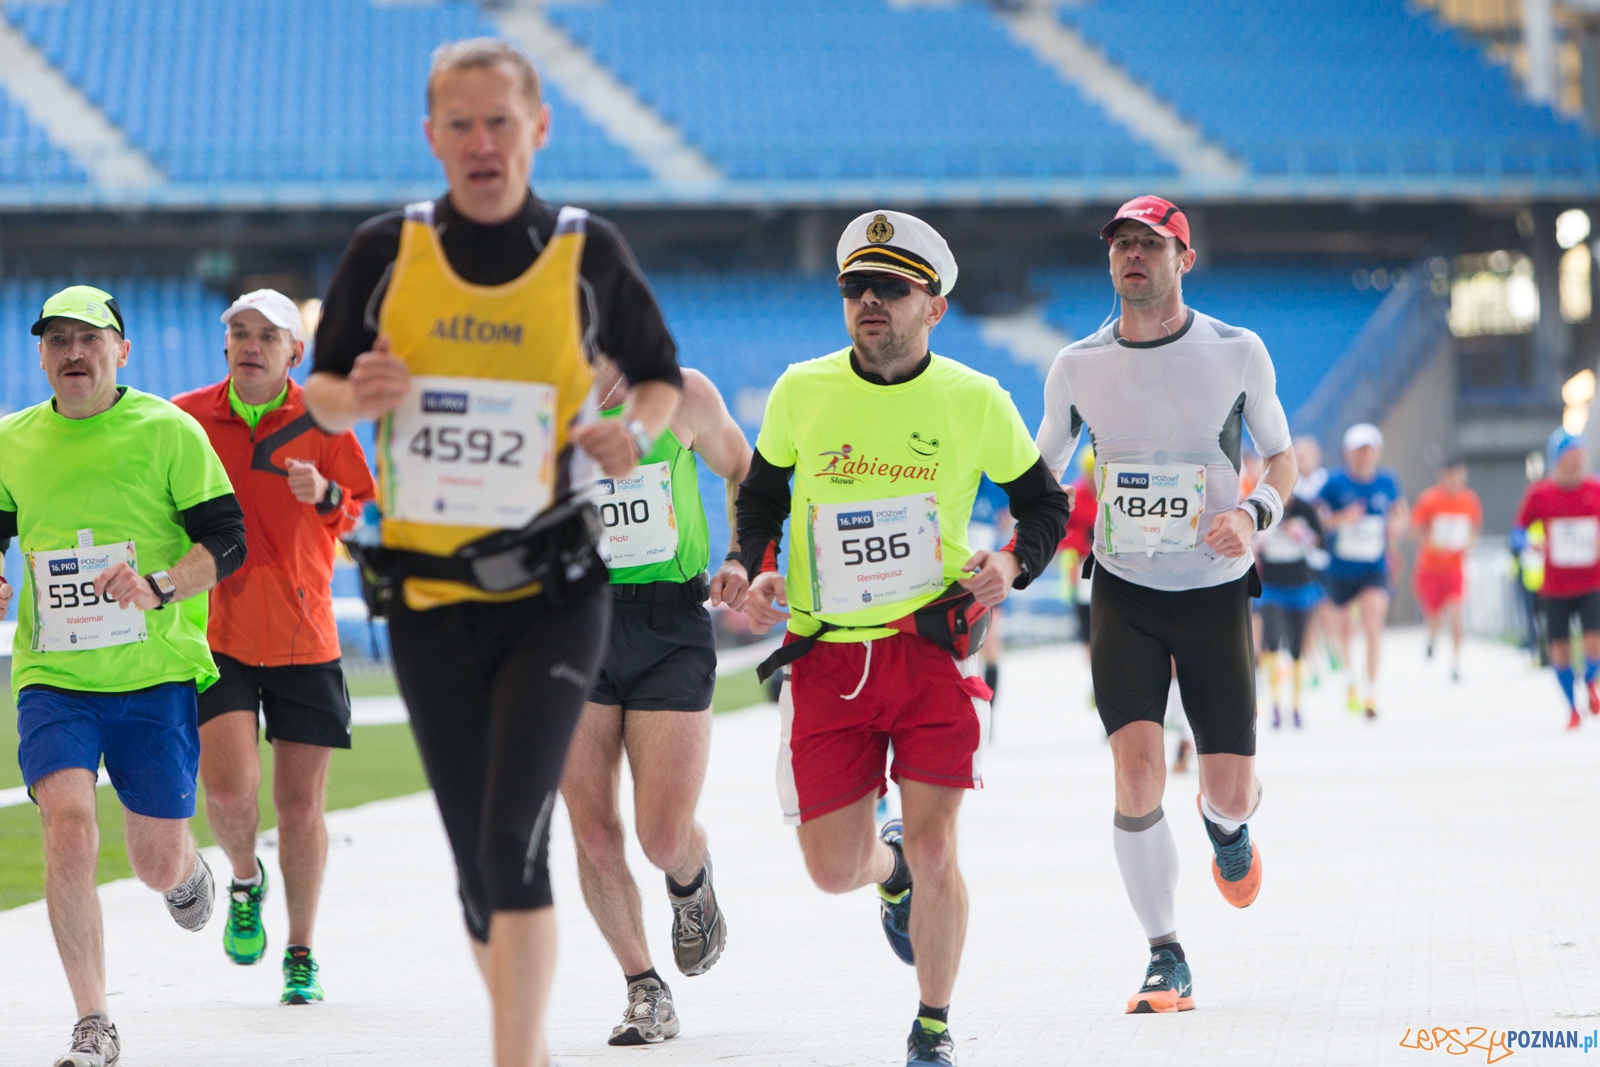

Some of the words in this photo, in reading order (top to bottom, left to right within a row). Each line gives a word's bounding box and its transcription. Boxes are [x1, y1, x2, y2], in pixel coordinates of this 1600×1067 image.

[409, 425, 525, 467] 4592
[609, 535, 629, 543] Piotr
[841, 532, 911, 566] 586
[857, 569, 904, 582] Remigiusz
[49, 580, 120, 609] 539
[66, 615, 104, 624] Waldemar
